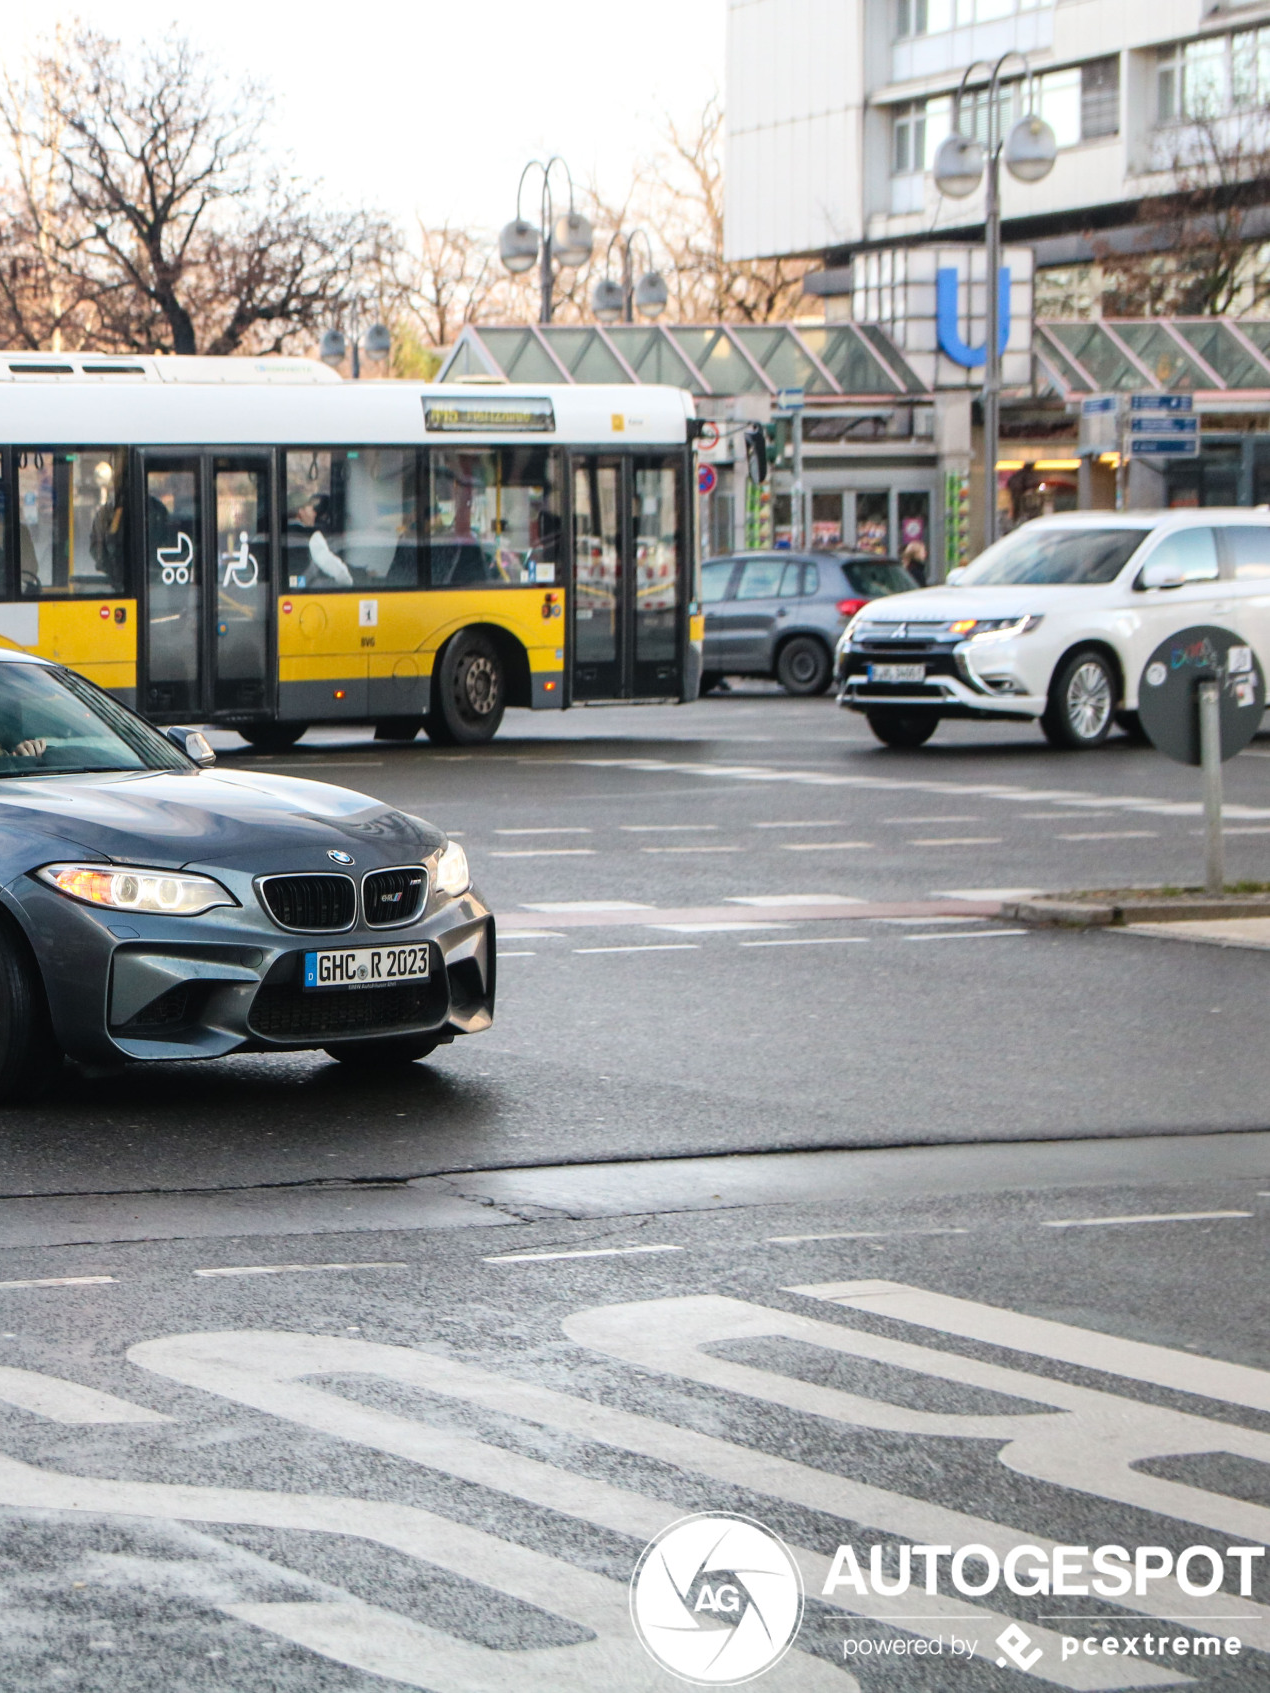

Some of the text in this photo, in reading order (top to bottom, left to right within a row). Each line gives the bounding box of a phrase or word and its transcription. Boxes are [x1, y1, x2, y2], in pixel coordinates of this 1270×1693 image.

[936, 266, 1011, 369] U
[308, 947, 428, 982] D GHC R 2023
